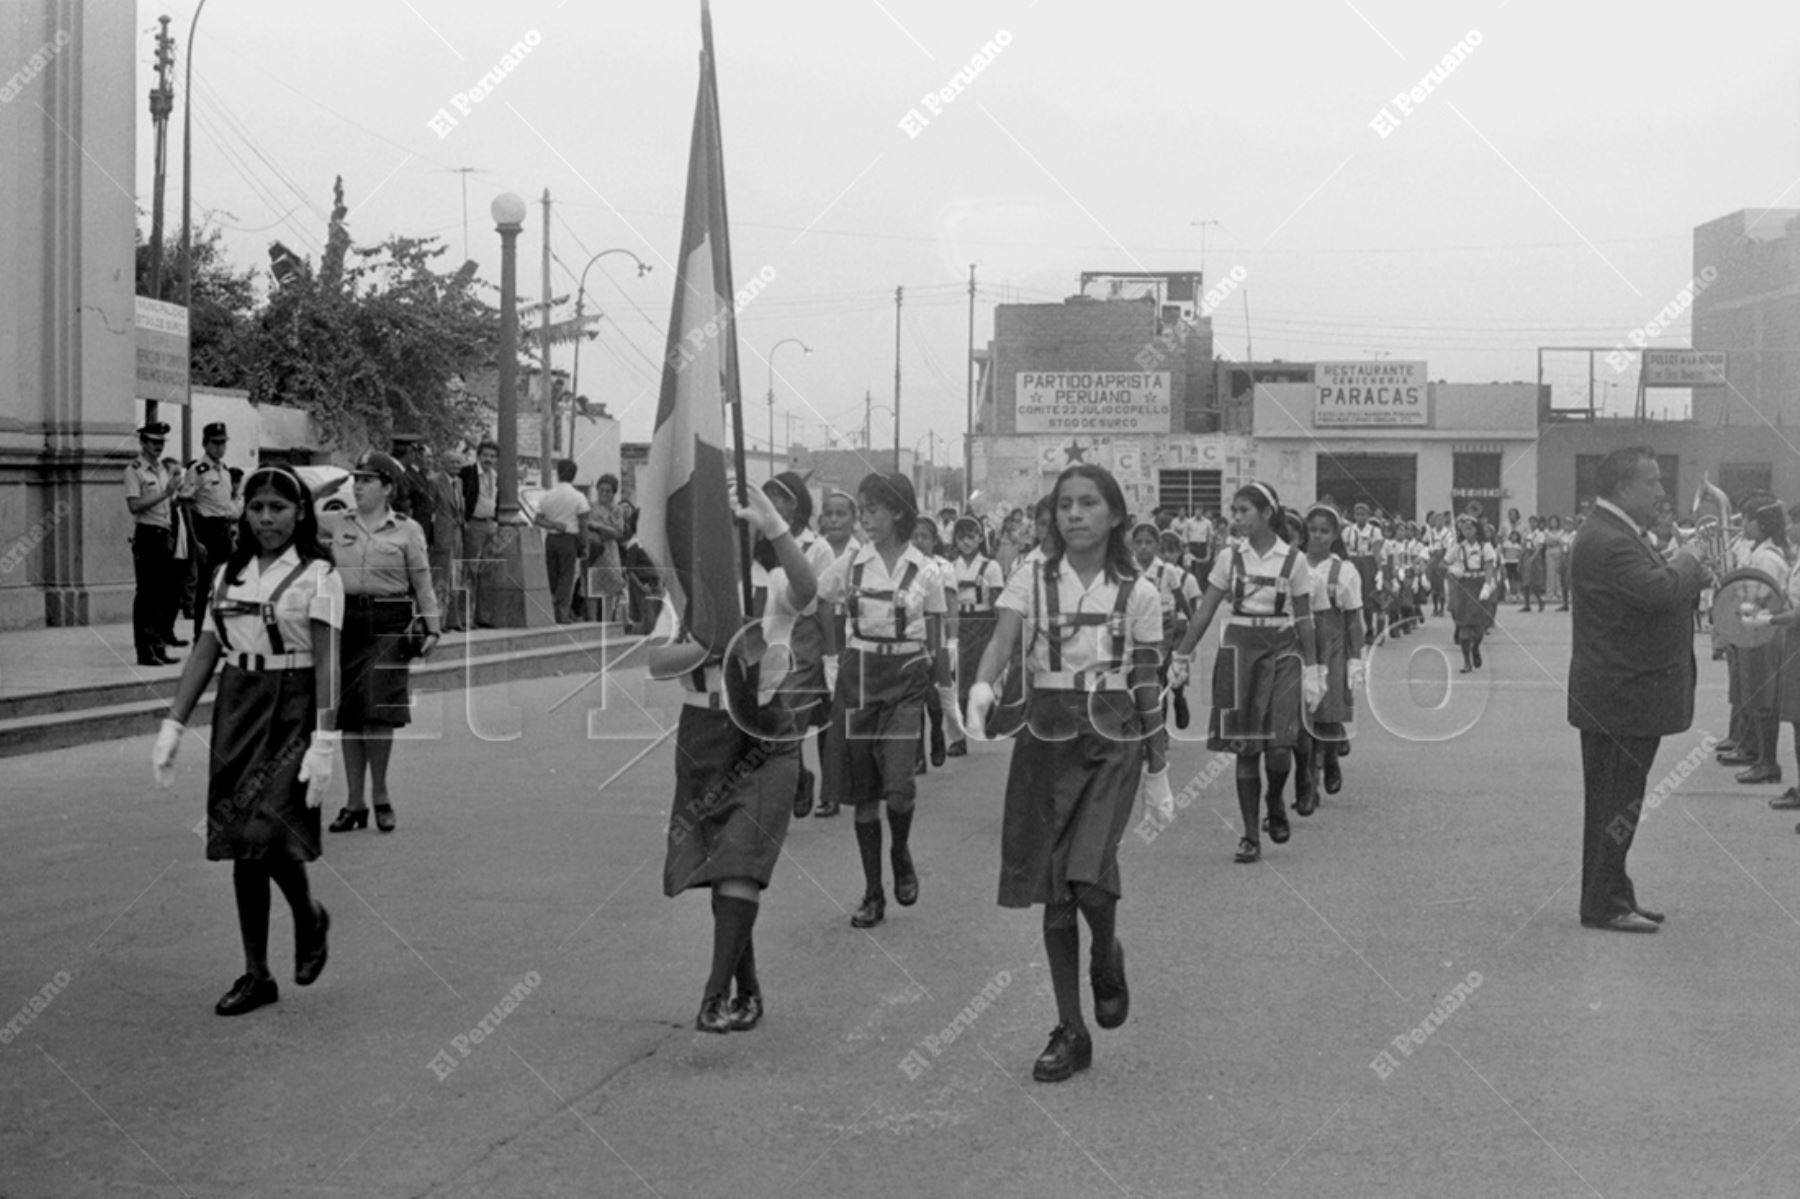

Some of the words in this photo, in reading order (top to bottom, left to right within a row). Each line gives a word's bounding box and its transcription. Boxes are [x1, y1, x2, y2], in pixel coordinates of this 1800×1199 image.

[1323, 365, 1415, 377] RESTAURANTE
[1023, 374, 1092, 389] PARTIDO
[1095, 374, 1162, 389] APRISTA
[1055, 389, 1132, 404] PERUANO
[1018, 405, 1060, 415] COMITE
[1078, 405, 1113, 415] JULIO
[1114, 405, 1169, 415] COPELLO
[1081, 418, 1096, 428] DE
